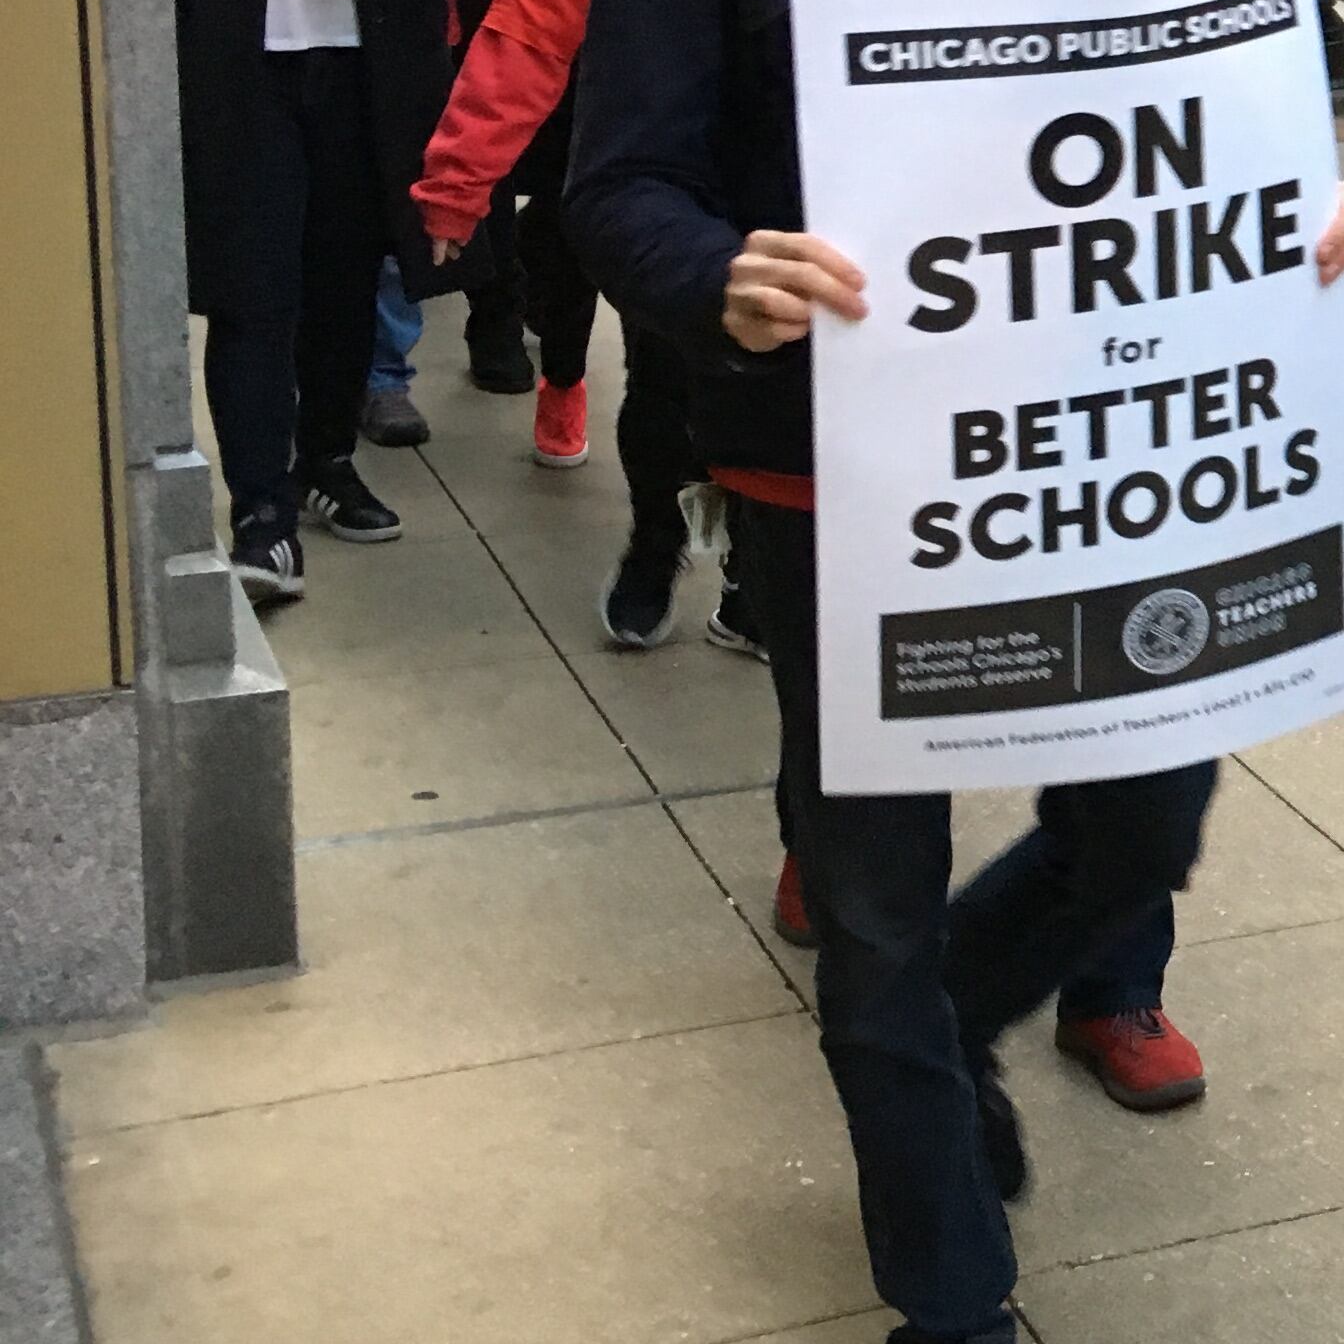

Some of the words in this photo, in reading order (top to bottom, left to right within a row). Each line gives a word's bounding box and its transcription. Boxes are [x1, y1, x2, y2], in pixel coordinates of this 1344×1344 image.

[859, 34, 1049, 72] CHICAGO
[1057, 20, 1183, 63] PUBLIC
[1026, 96, 1208, 209] ON
[906, 178, 1306, 335] STRIKE
[1103, 336, 1163, 367] for
[951, 357, 1282, 481] BETTER
[910, 428, 1321, 570] SCHOOLS
[1216, 581, 1318, 627] TEACHERS
